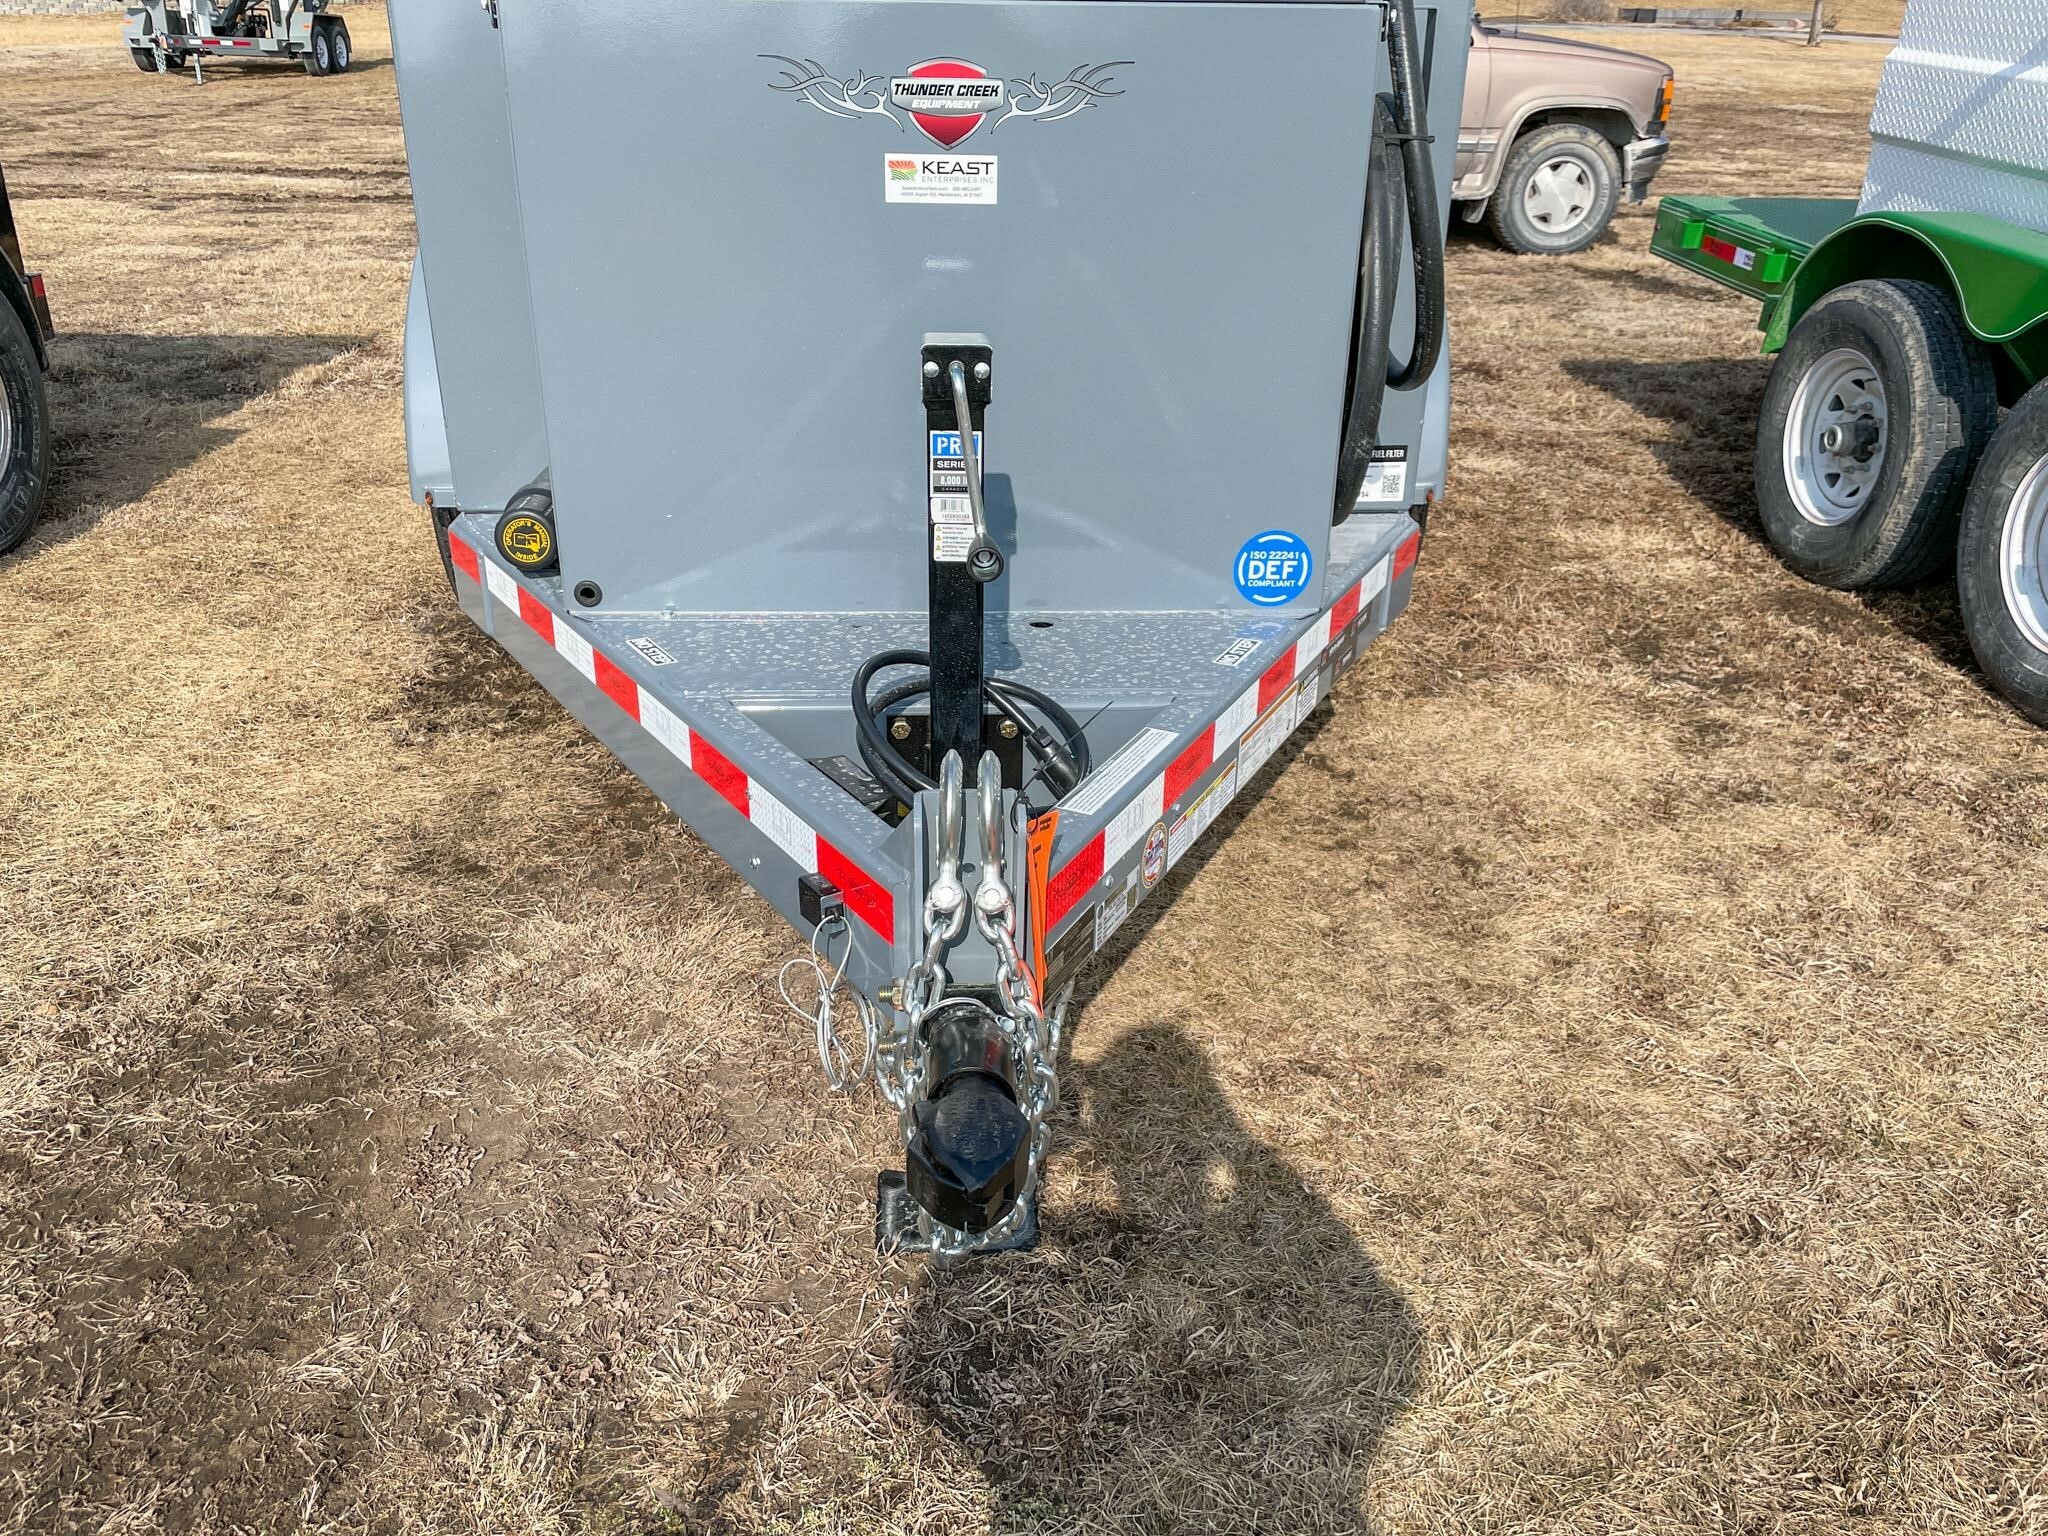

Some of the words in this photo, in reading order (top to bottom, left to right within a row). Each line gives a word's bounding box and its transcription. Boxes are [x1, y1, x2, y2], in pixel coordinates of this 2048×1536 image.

[894, 83, 954, 96] THUNDER
[957, 85, 999, 97] CREEK
[911, 99, 982, 109] EQUIPMENT
[922, 161, 994, 175] KEAST
[921, 175, 978, 184] ENTERPRISES
[937, 436, 962, 455] PR
[1371, 449, 1385, 458] FUEL
[1385, 449, 1404, 458] FILTER
[936, 460, 966, 469] SERIE
[505, 520, 532, 546] OPERATOR'S
[533, 524, 548, 548] MANUAL
[515, 551, 539, 560] INSIDE
[1250, 551, 1267, 559] ISO
[1268, 551, 1299, 560] 22241
[1248, 560, 1298, 580] DEF
